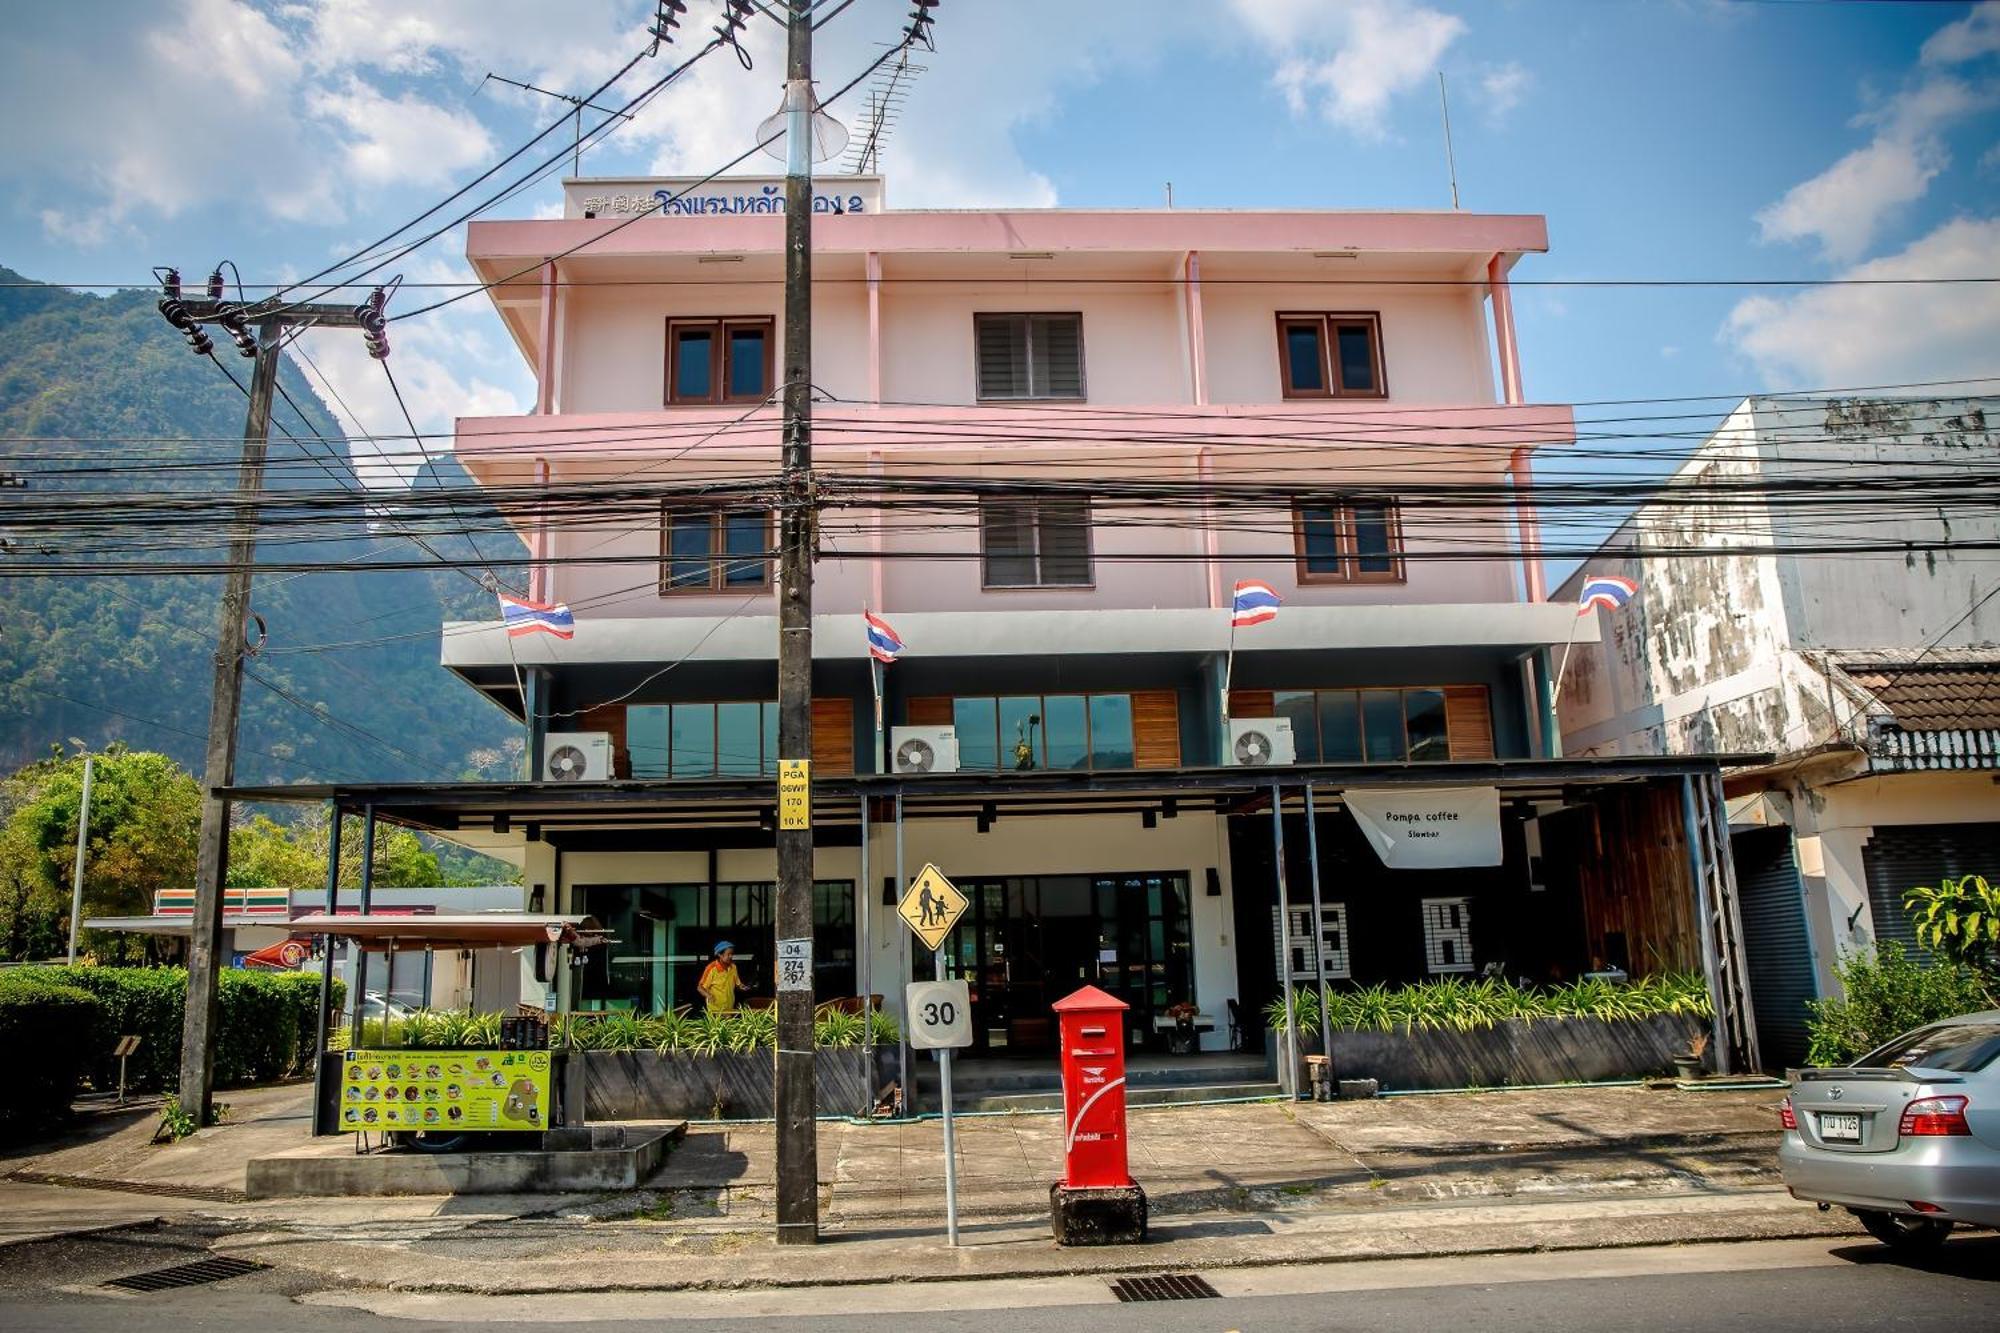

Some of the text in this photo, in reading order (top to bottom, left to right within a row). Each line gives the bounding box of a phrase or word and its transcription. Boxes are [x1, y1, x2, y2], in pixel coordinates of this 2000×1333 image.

[847, 195, 863, 213] 2
[783, 771, 805, 779] PGA
[786, 797, 802, 806] 170
[1386, 811, 1458, 824] Pompa coffee
[786, 944, 801, 955] 04
[784, 960, 804, 971] 274
[924, 1001, 956, 1026] 30
